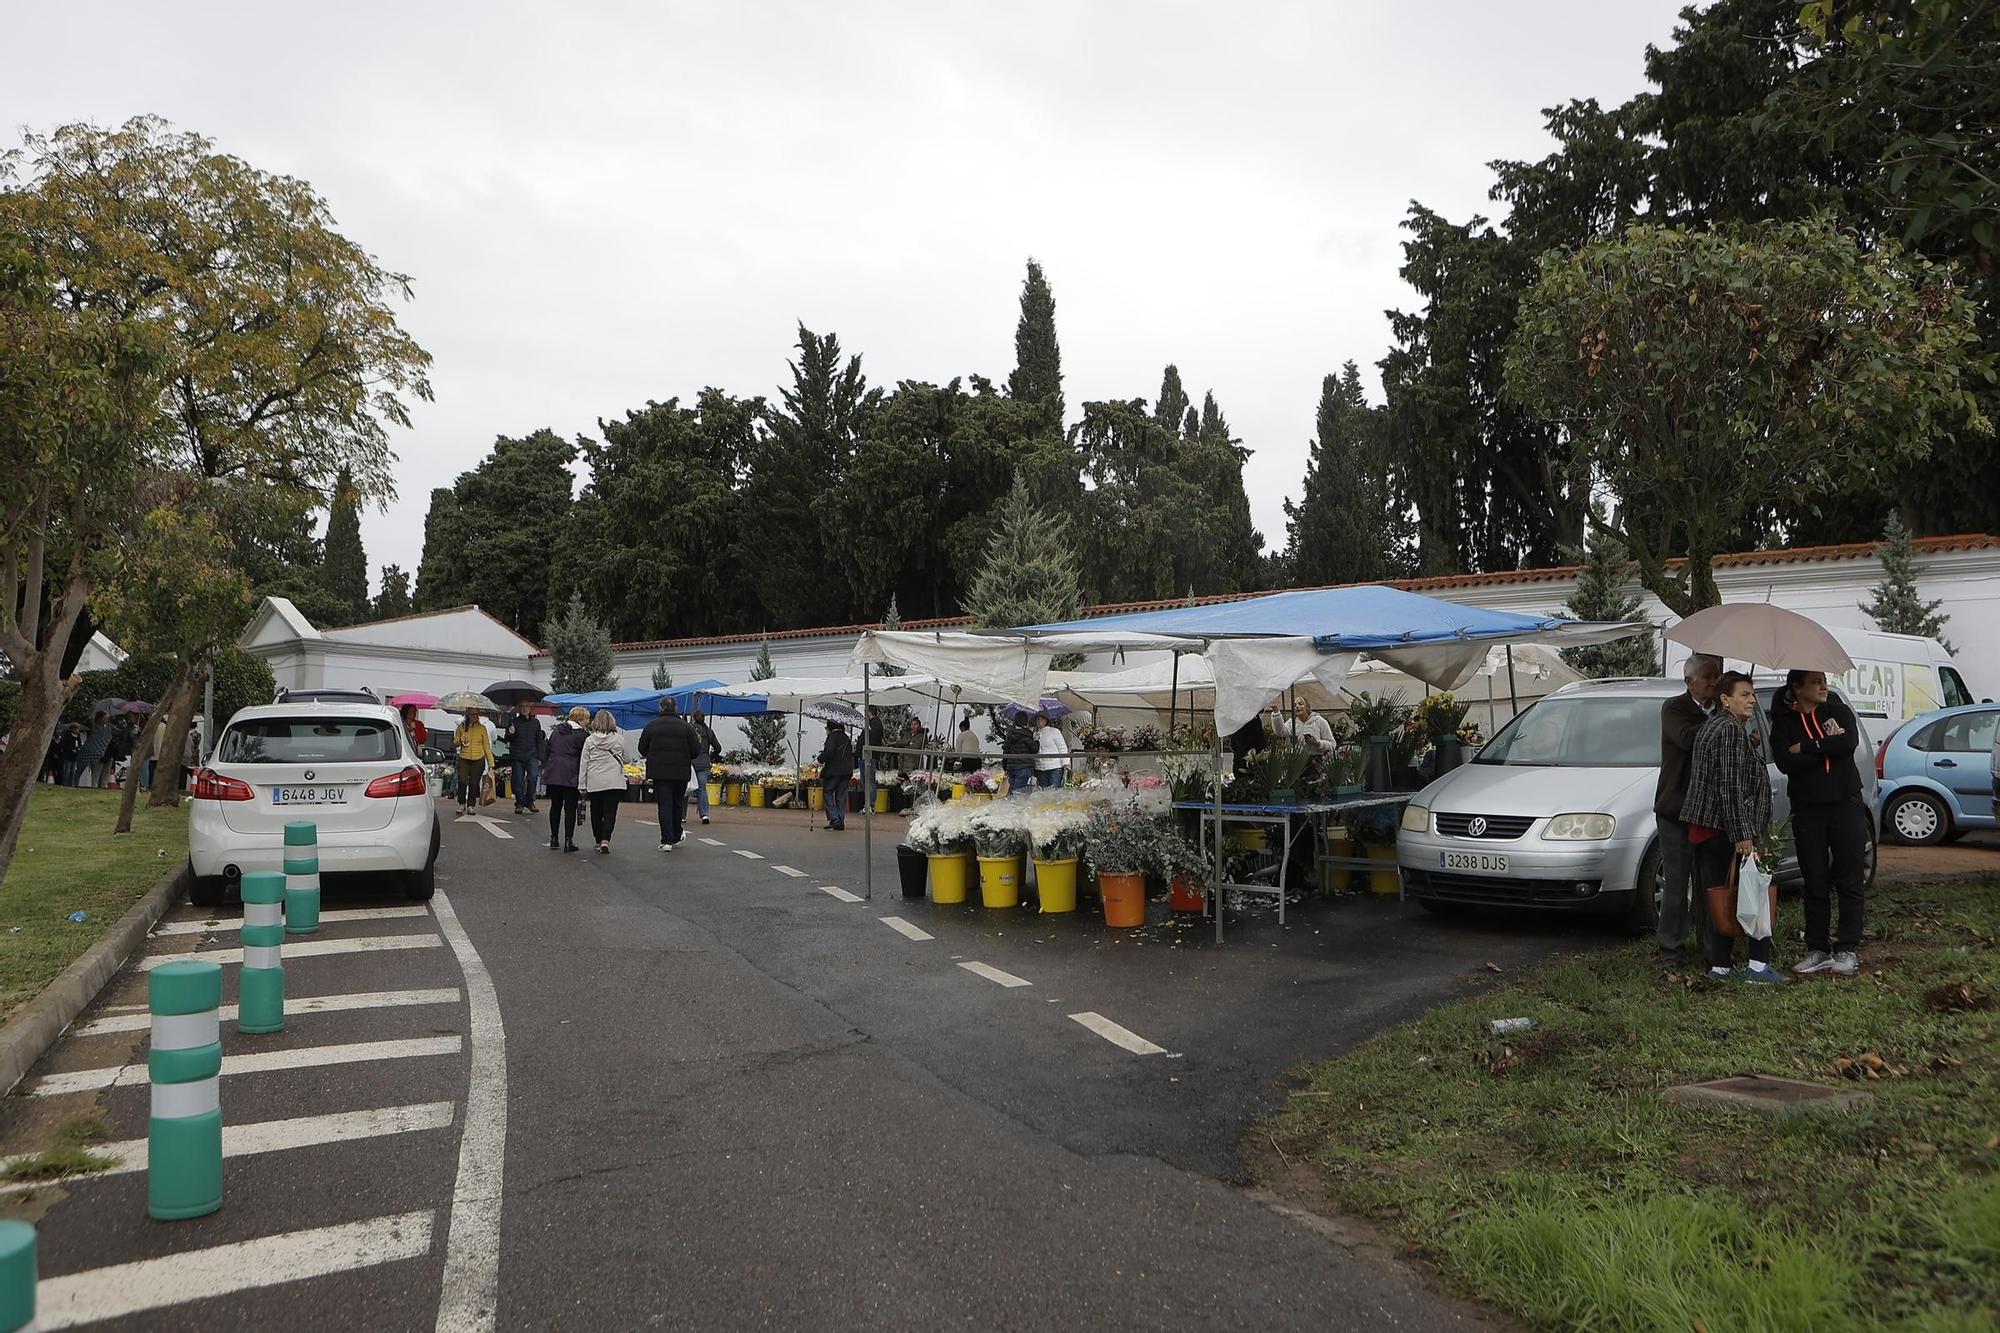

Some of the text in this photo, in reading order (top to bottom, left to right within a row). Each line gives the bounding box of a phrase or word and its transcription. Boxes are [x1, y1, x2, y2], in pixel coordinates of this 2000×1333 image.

[1876, 700, 1895, 712] RENT
[282, 788, 344, 801] 6448 JGV
[1448, 854, 1506, 871] 3238 DJS
